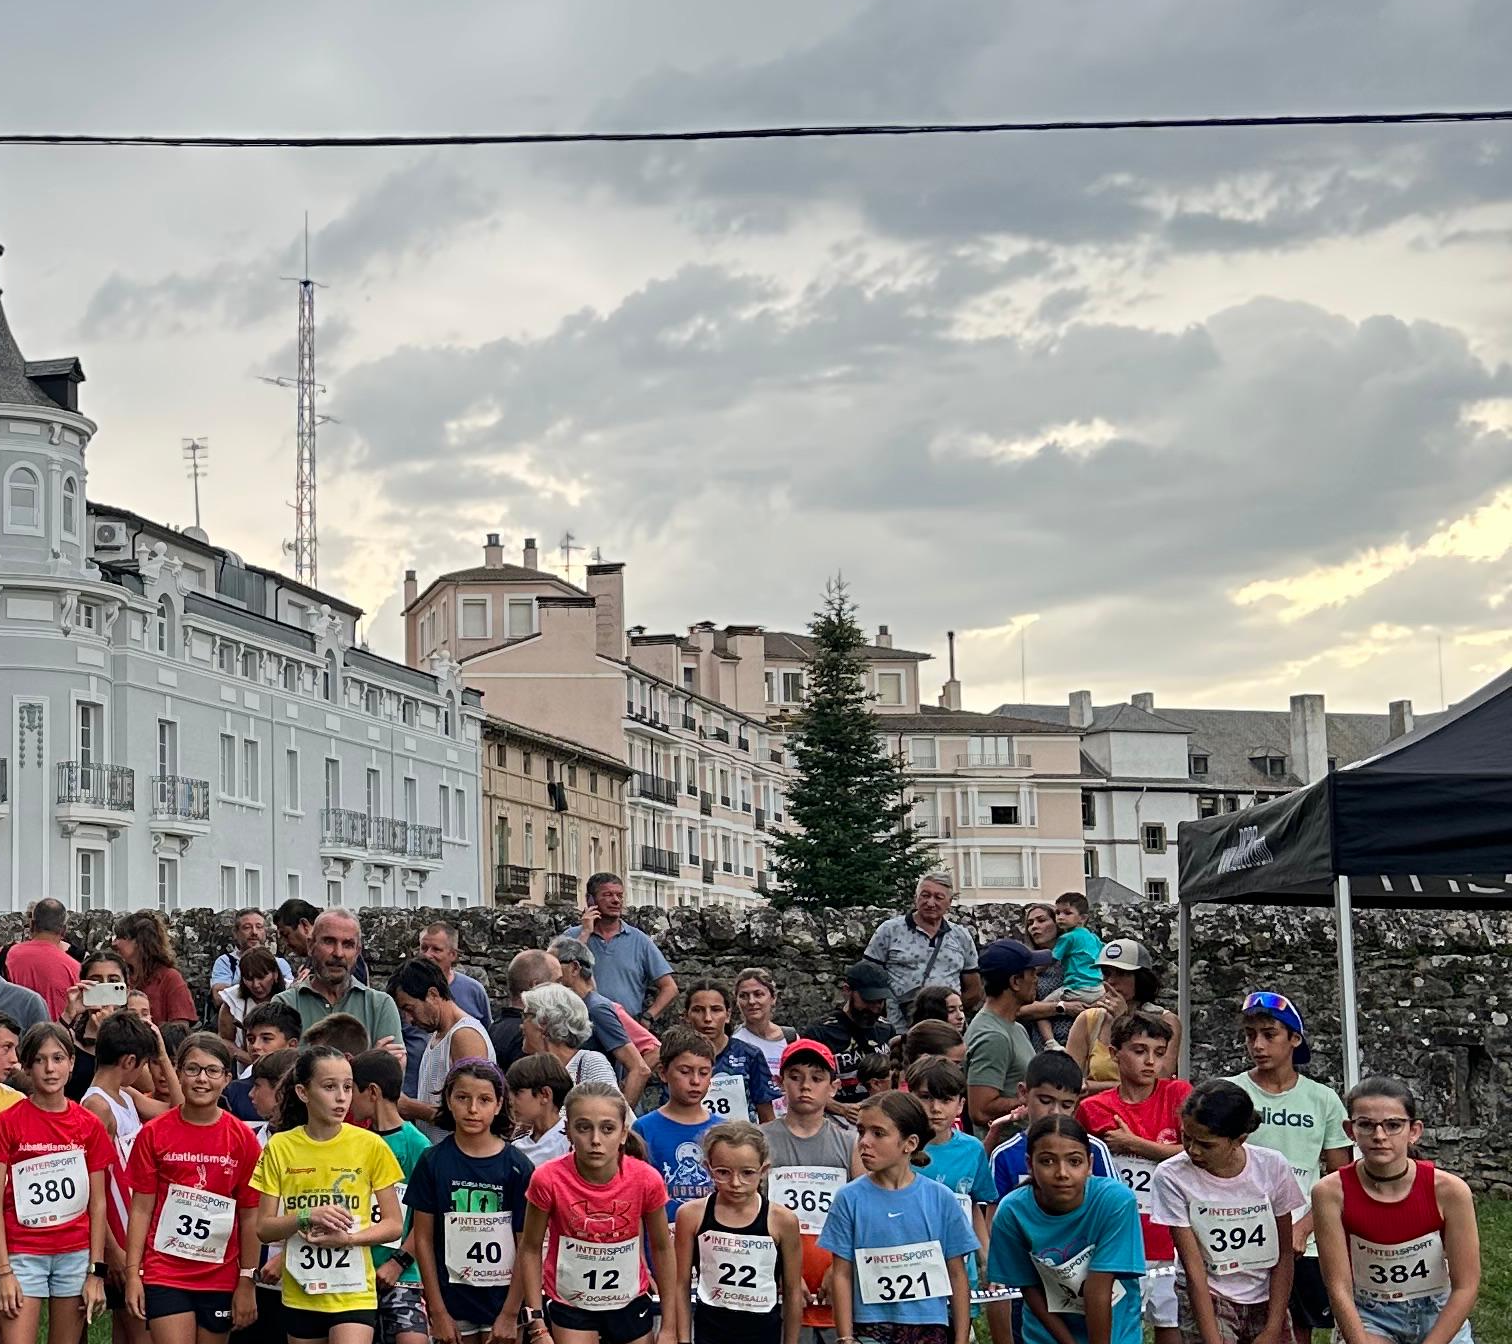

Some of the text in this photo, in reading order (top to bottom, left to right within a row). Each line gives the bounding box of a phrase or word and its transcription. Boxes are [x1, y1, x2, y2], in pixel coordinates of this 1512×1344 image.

[25, 1157, 77, 1173] INTERSPORT
[784, 1172, 840, 1182] INTERSPORT
[1121, 1168, 1151, 1193] 32
[28, 1177, 76, 1205] 380
[176, 1189, 230, 1209] INTERSPORT
[287, 1194, 360, 1210] SCORPIO
[784, 1188, 832, 1213] 365
[176, 1214, 211, 1240] 35
[458, 1216, 512, 1226] INTERSPORT
[575, 1242, 635, 1256] INTERSPORT
[712, 1236, 774, 1250] INTERSPORT
[1209, 1224, 1266, 1252] 394
[1367, 1239, 1434, 1256] INTERSPORT
[299, 1245, 350, 1270] 302
[467, 1241, 502, 1264] 40
[873, 1249, 934, 1263] INTERSPORT
[583, 1269, 619, 1290] 12
[718, 1263, 756, 1289] 22
[1369, 1259, 1430, 1284] 384
[878, 1272, 931, 1301] 321
